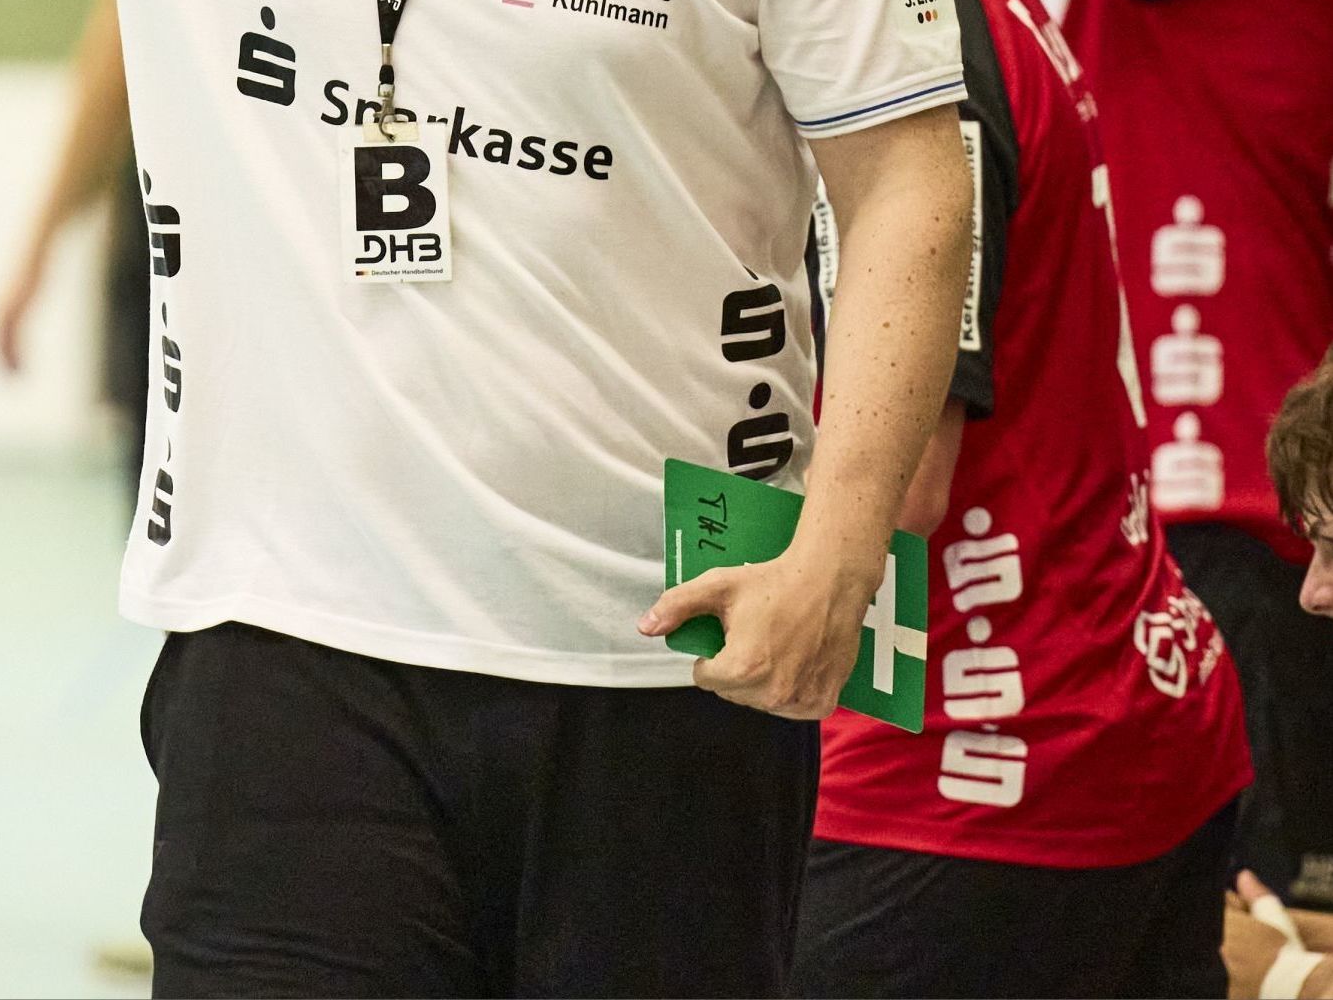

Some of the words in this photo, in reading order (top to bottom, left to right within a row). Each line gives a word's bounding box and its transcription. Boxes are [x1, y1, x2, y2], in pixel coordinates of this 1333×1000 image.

[354, 146, 436, 231] B
[355, 233, 442, 264] DHB
[371, 269, 401, 277] Deutscher
[402, 267, 444, 276] Handballbund
